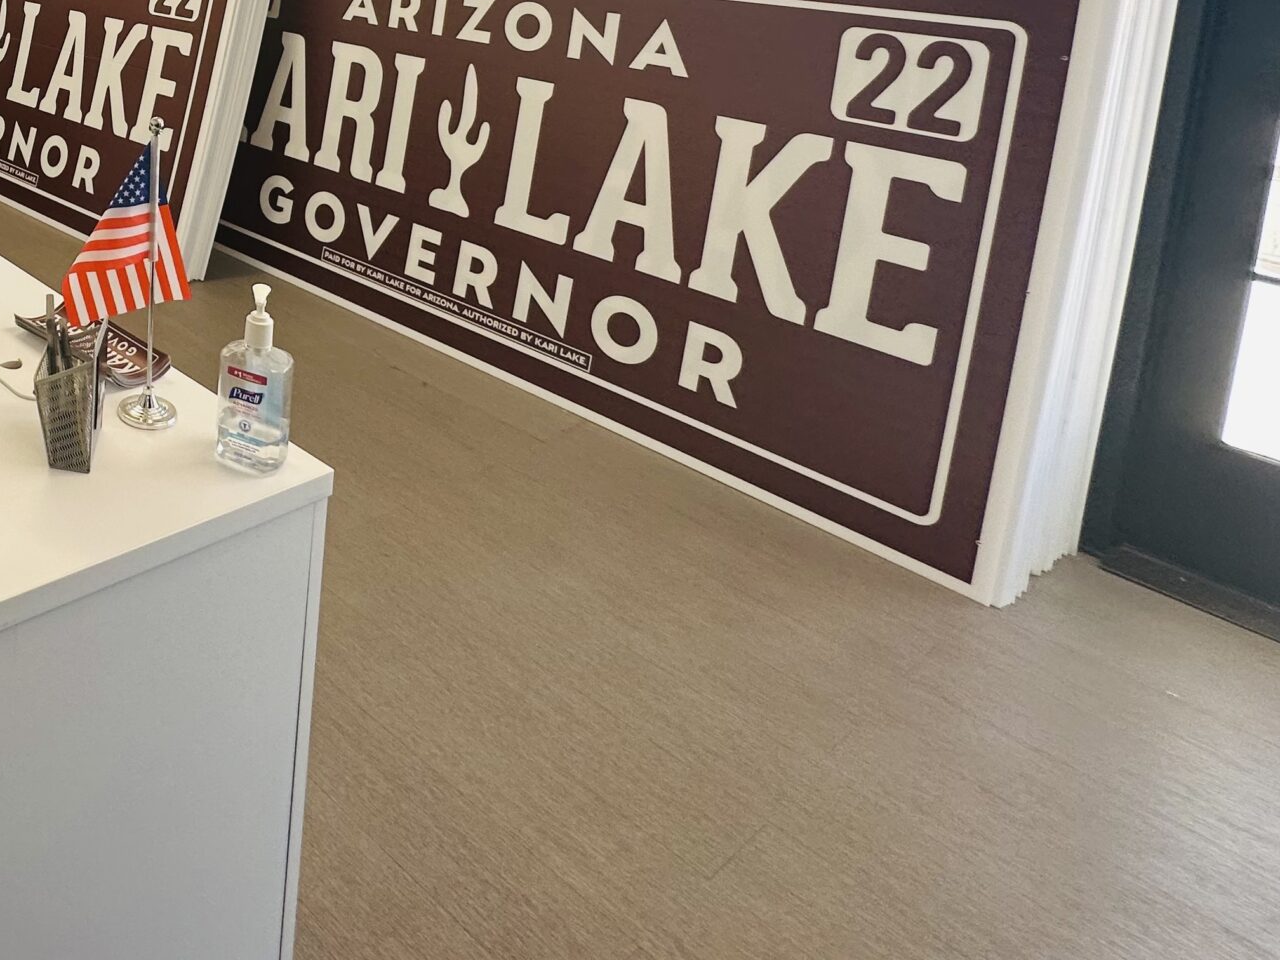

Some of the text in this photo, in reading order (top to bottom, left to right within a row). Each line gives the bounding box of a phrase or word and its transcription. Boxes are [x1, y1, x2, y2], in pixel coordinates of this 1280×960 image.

[6, 0, 194, 153] LAKE
[847, 30, 974, 138] 22
[239, 30, 968, 367] ARI LAKE
[259, 175, 744, 409] GOVERNOR
[324, 251, 340, 262] PAID
[341, 259, 355, 270] FOR
[356, 265, 365, 273] BY
[366, 268, 385, 281] KARI
[385, 276, 404, 289] LAKE
[405, 284, 421, 296] FOR
[462, 308, 519, 336] AUTHORIZED
[520, 332, 534, 342] BY
[534, 337, 558, 353] KARI
[233, 387, 260, 404] Purell
